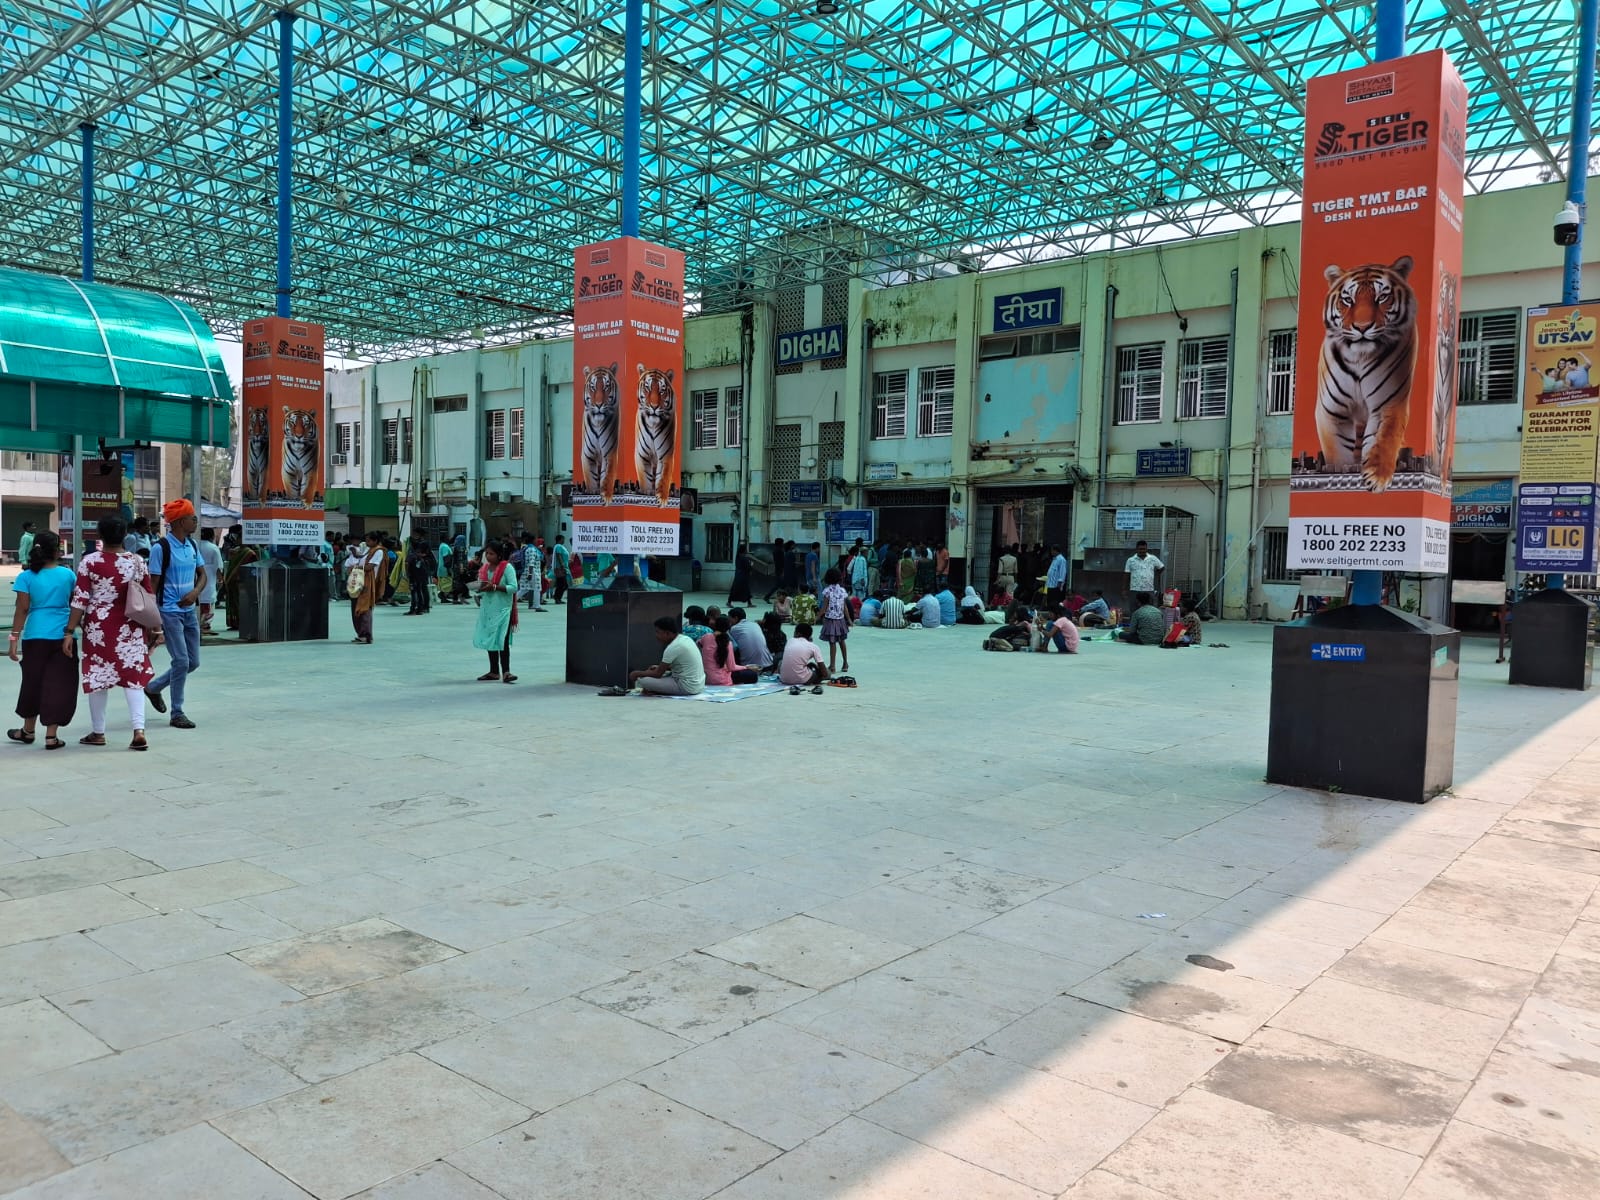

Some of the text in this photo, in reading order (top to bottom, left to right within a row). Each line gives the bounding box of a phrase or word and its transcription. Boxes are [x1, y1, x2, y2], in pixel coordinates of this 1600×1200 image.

[1349, 76, 1392, 90] SHYAM
[1348, 121, 1428, 150] TIGER
[1352, 155, 1373, 163] TMT
[1312, 186, 1428, 213] TIGER TMT BAR
[1324, 202, 1419, 222] DESH KI DAHAAD
[591, 280, 623, 296] TIGER
[646, 283, 679, 301] TIGER
[1000, 296, 1056, 326] दीघा
[578, 324, 594, 332] TIGER
[597, 321, 608, 329] TMT
[630, 320, 679, 337] TIGER TMT BAR
[1538, 330, 1593, 344] UTSAV
[779, 330, 840, 361] DIGHA
[290, 348, 320, 360] TIGER
[1529, 410, 1592, 418] GUARANTEED
[1528, 425, 1592, 433] CELEBRATION
[1457, 514, 1494, 522] DIGHA
[648, 526, 663, 534] FREE
[1305, 525, 1405, 537] TOLL FREE NO
[1551, 529, 1579, 546] LIC
[1302, 540, 1406, 552] 1800 202 2233
[1301, 556, 1404, 567] www.seltigertmt.com
[1333, 647, 1363, 657] ENTRY
